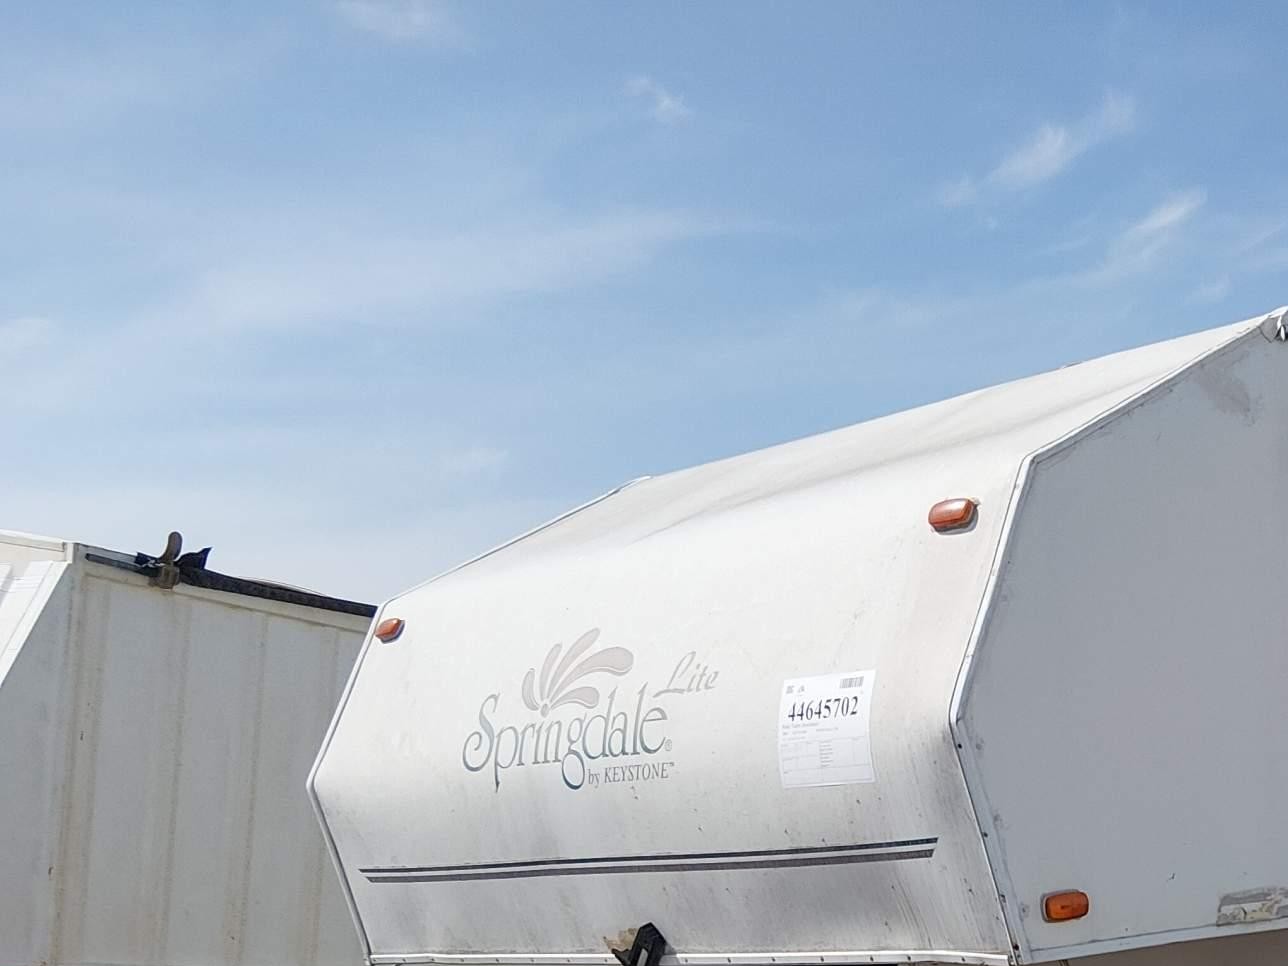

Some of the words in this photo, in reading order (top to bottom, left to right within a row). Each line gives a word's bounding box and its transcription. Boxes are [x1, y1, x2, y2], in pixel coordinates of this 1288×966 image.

[653, 651, 720, 698] Lite
[788, 695, 858, 722] 44645702
[462, 682, 668, 794] Springdale
[588, 768, 601, 786] by
[604, 763, 669, 784] KEYSTONE
